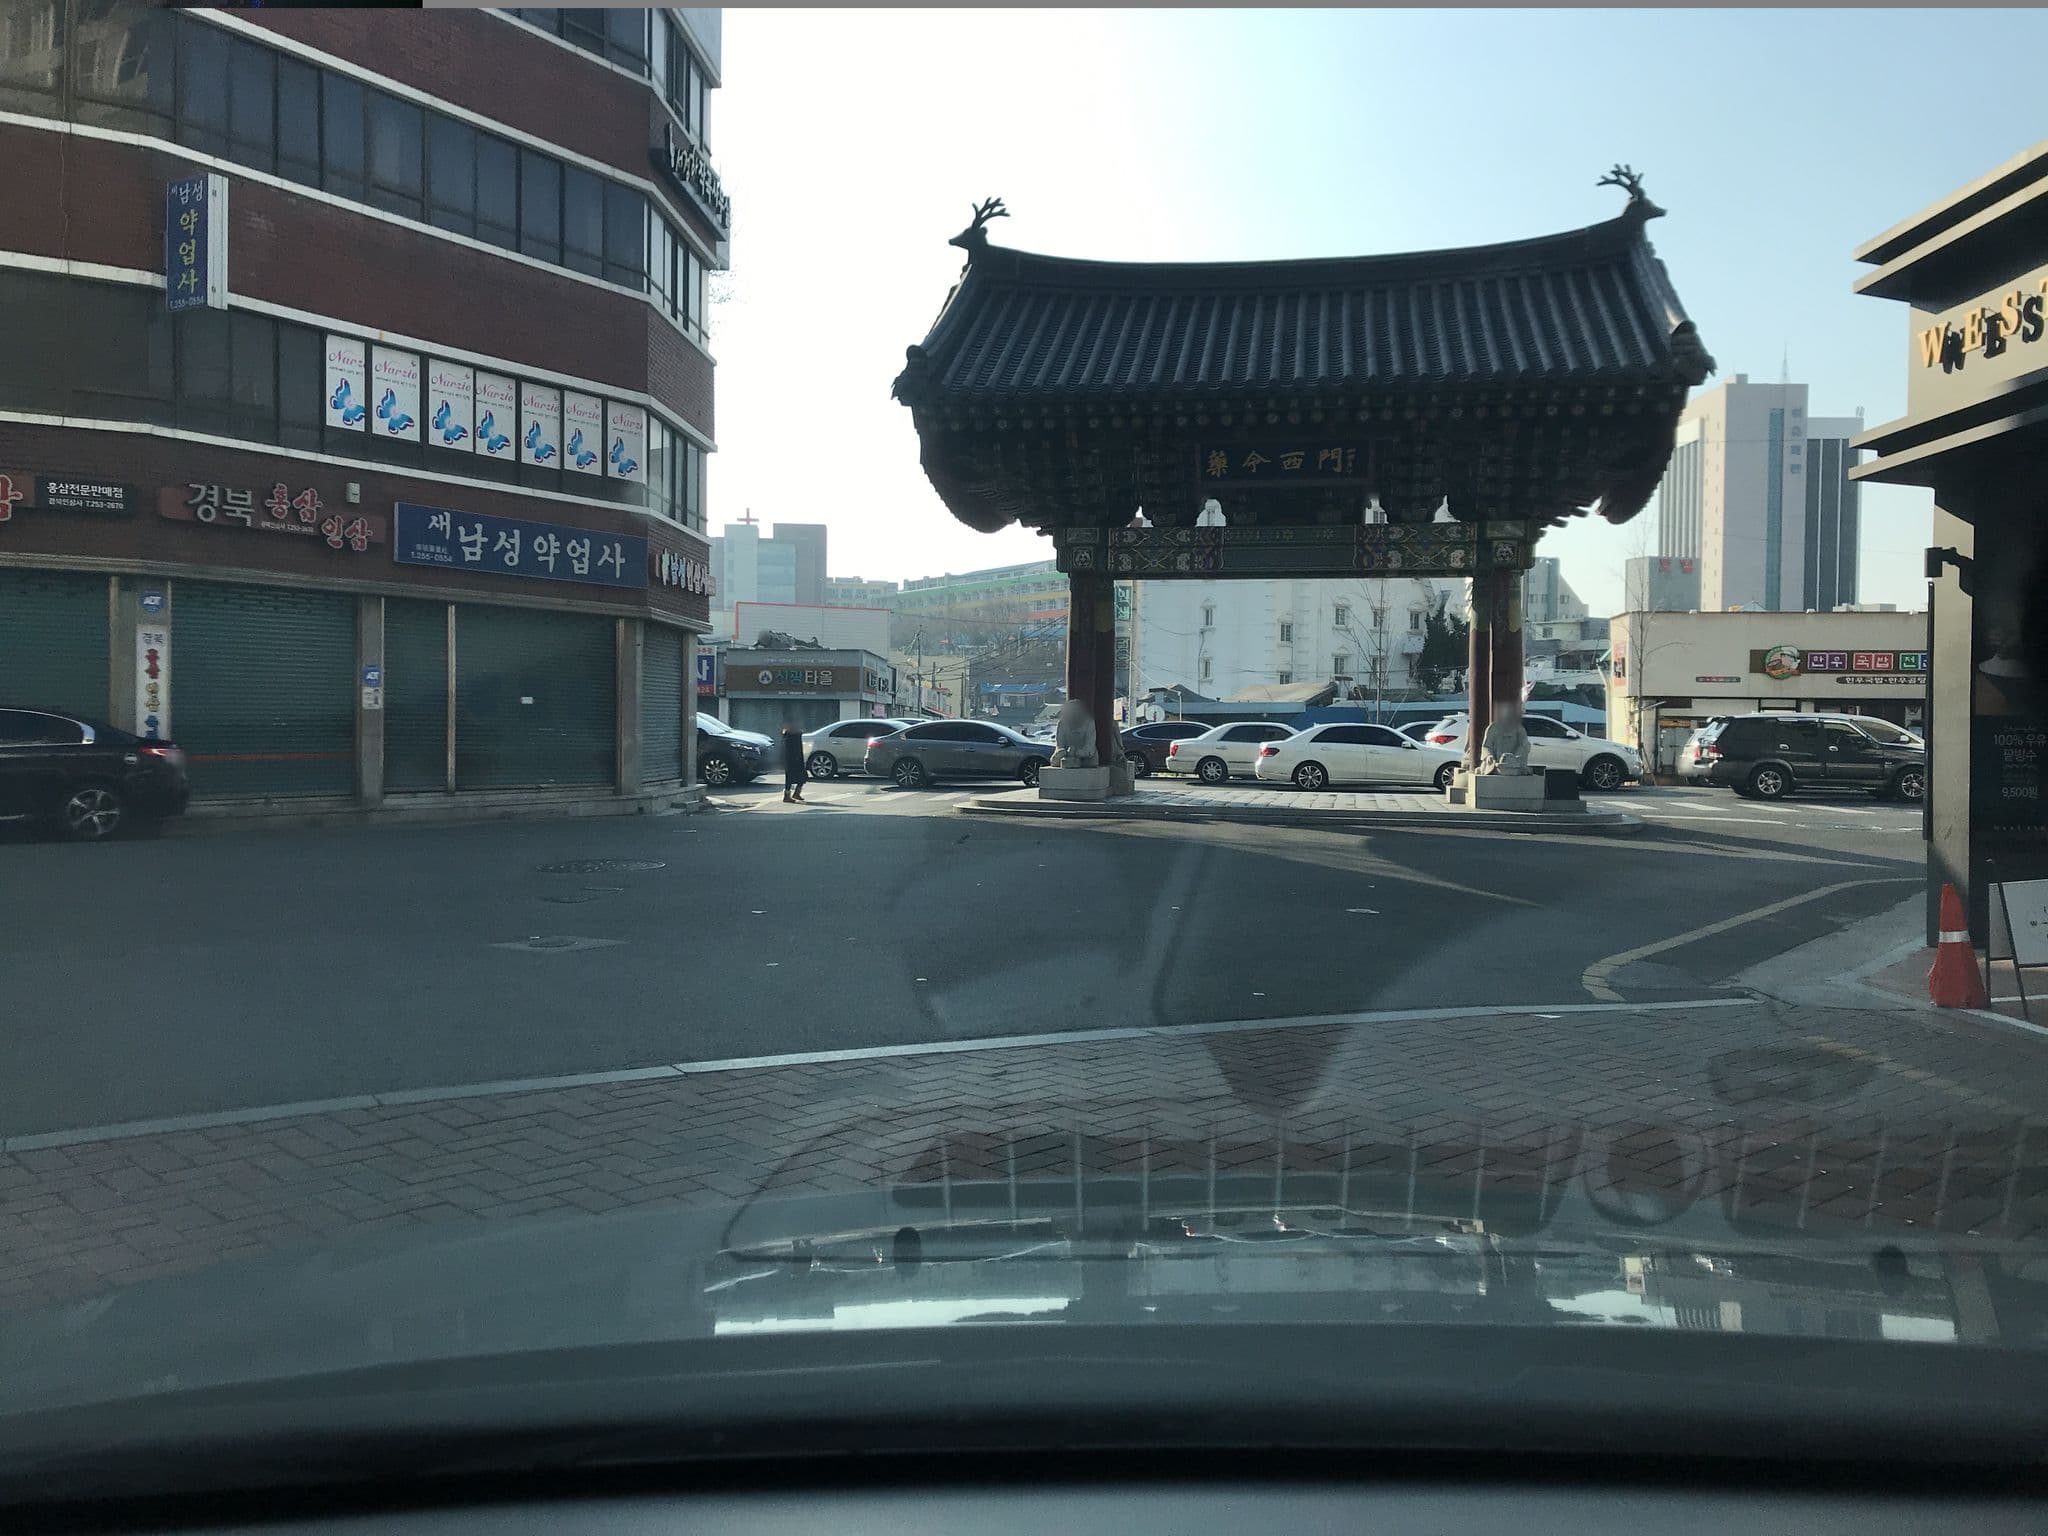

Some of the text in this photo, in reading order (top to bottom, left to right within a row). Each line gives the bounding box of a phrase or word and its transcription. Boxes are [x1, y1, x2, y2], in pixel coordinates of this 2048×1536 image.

[177, 208, 199, 294] 약업사
[47, 482, 123, 499] 홍삼전문판매점
[188, 482, 324, 527] 경북 홍삼
[321, 515, 375, 551] 인삼
[533, 532, 627, 579] 약업사
[1809, 653, 1844, 669] 한우
[1854, 653, 1890, 669] 국밥
[775, 669, 833, 686] 신광타올
[1993, 734, 2024, 746] 100%
